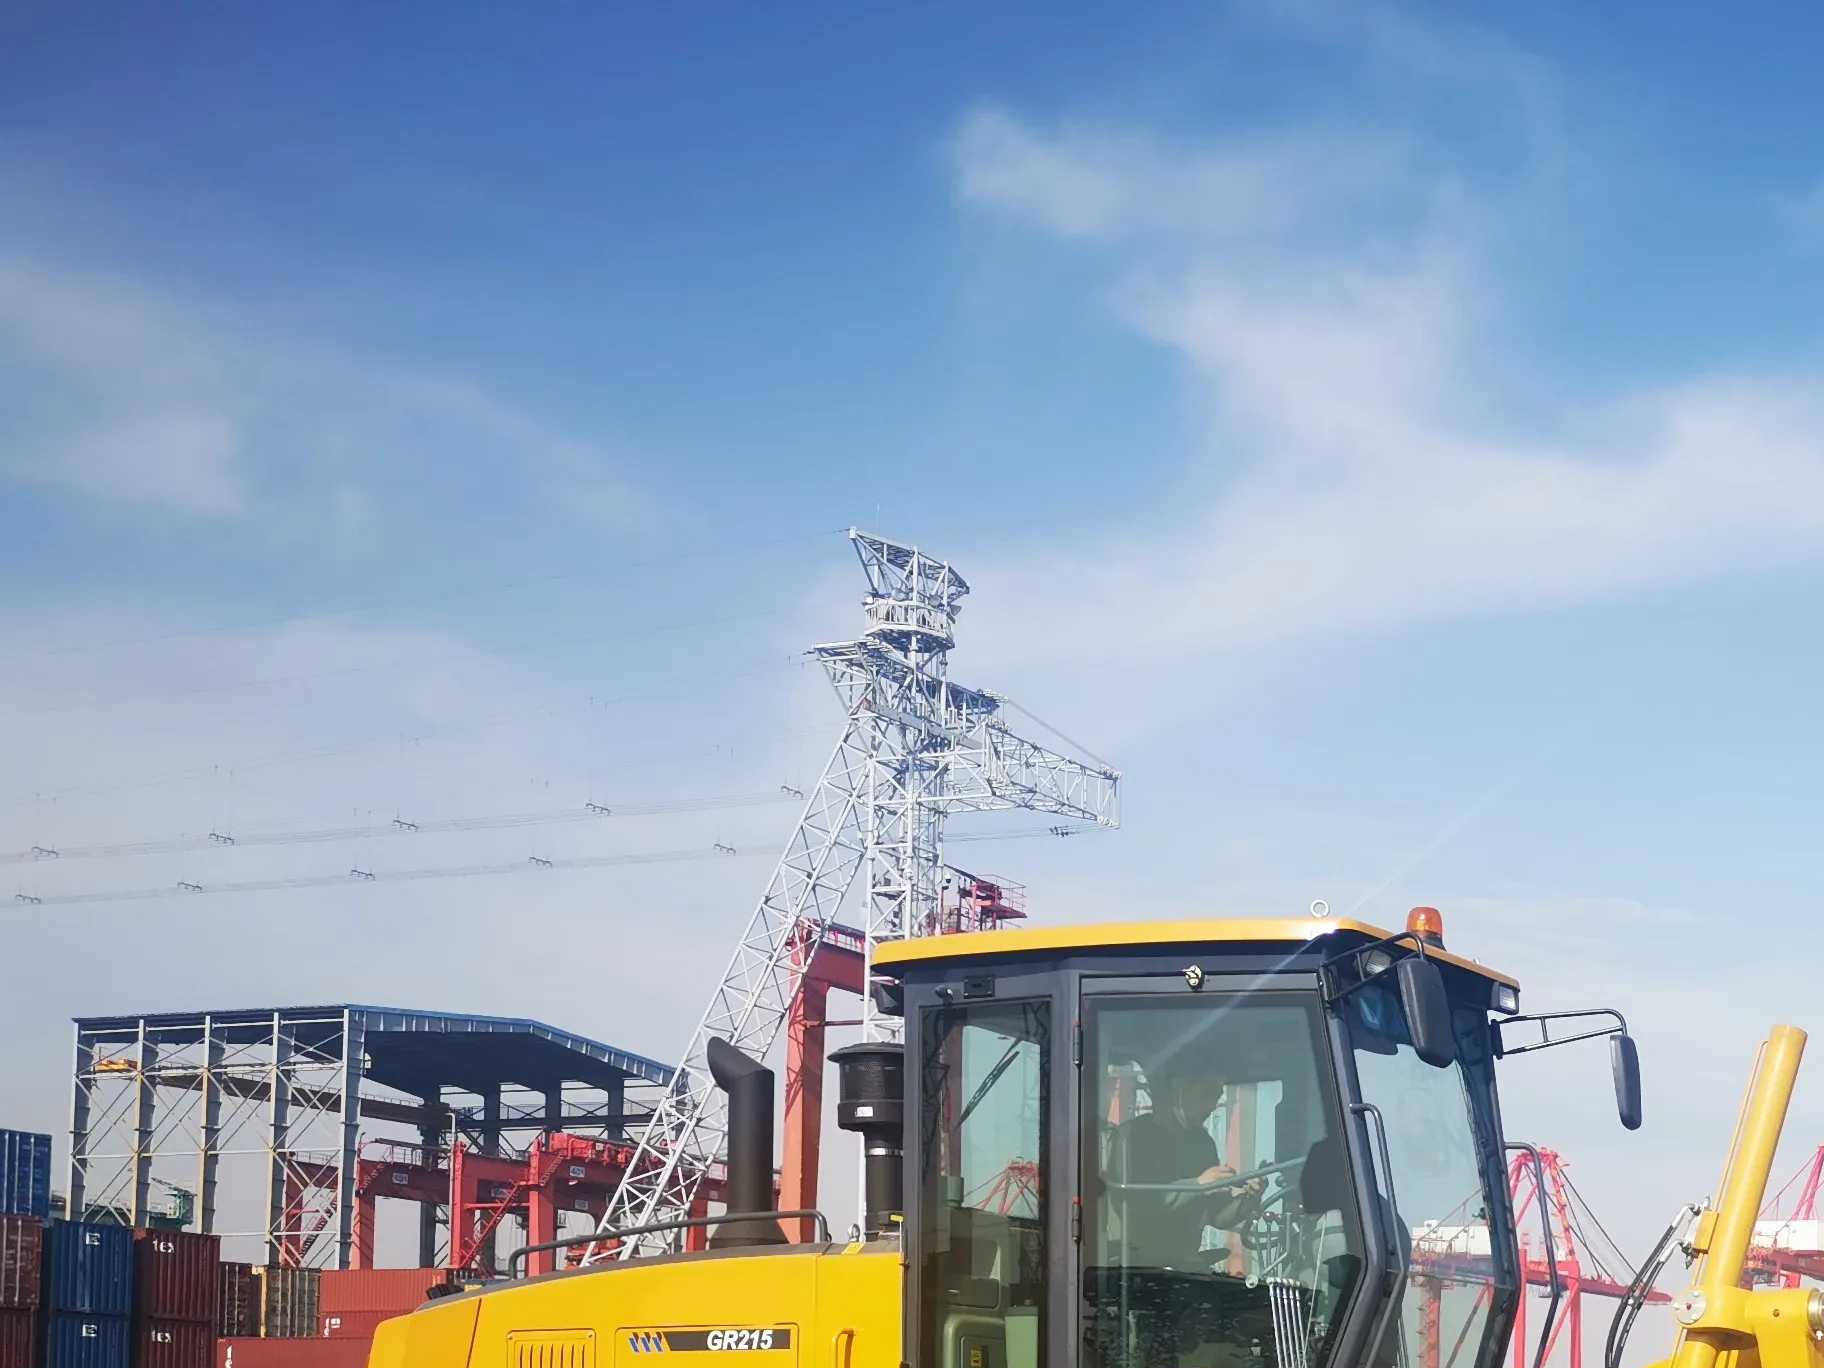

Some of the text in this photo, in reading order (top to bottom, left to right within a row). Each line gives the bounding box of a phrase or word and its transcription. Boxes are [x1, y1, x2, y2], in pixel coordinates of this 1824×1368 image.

[152, 1239, 175, 1254] tex
[151, 1329, 172, 1344] tex
[706, 1329, 773, 1351] GR215
